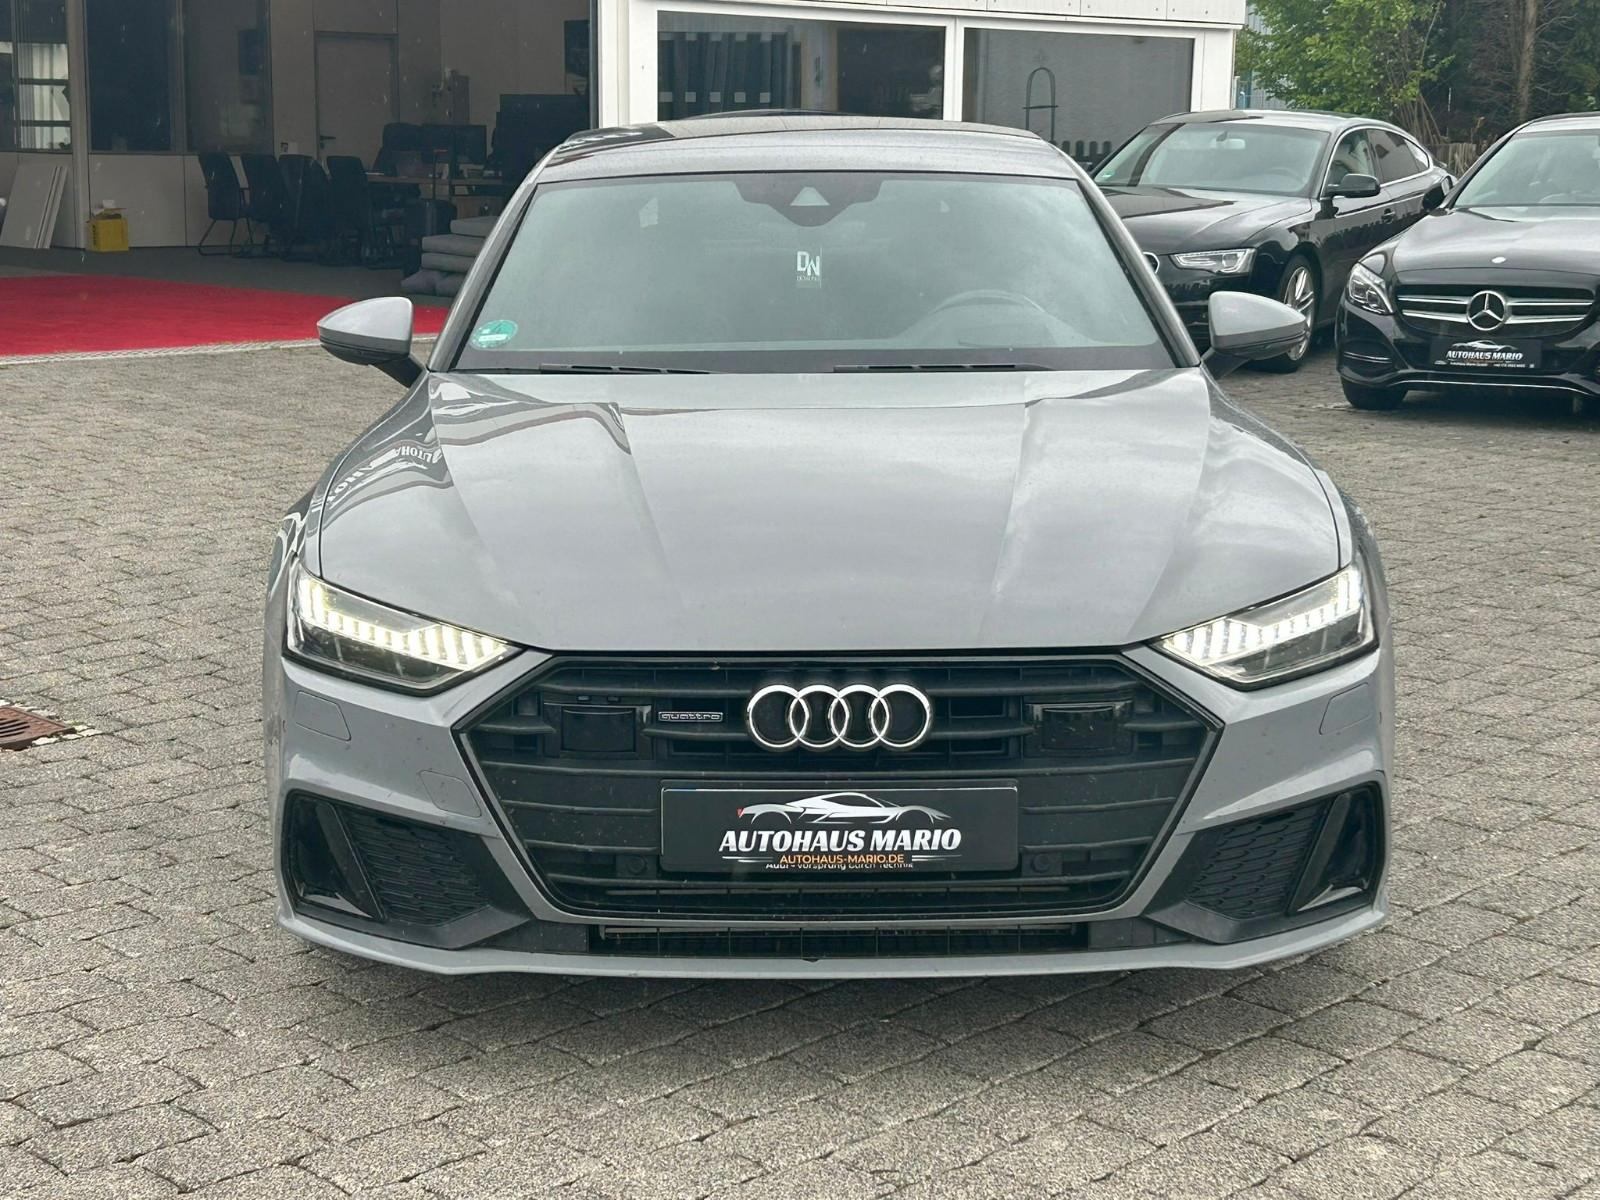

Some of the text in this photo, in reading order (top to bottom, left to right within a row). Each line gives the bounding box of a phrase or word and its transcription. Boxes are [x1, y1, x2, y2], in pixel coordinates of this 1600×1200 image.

[1446, 350, 1491, 360] AUTOHAUS
[1492, 352, 1524, 361] MARIO
[661, 713, 720, 721] quattro
[719, 829, 961, 852] AUTOHAUS MARIO
[780, 854, 905, 865] AUTOHAUS-MARIO.DE
